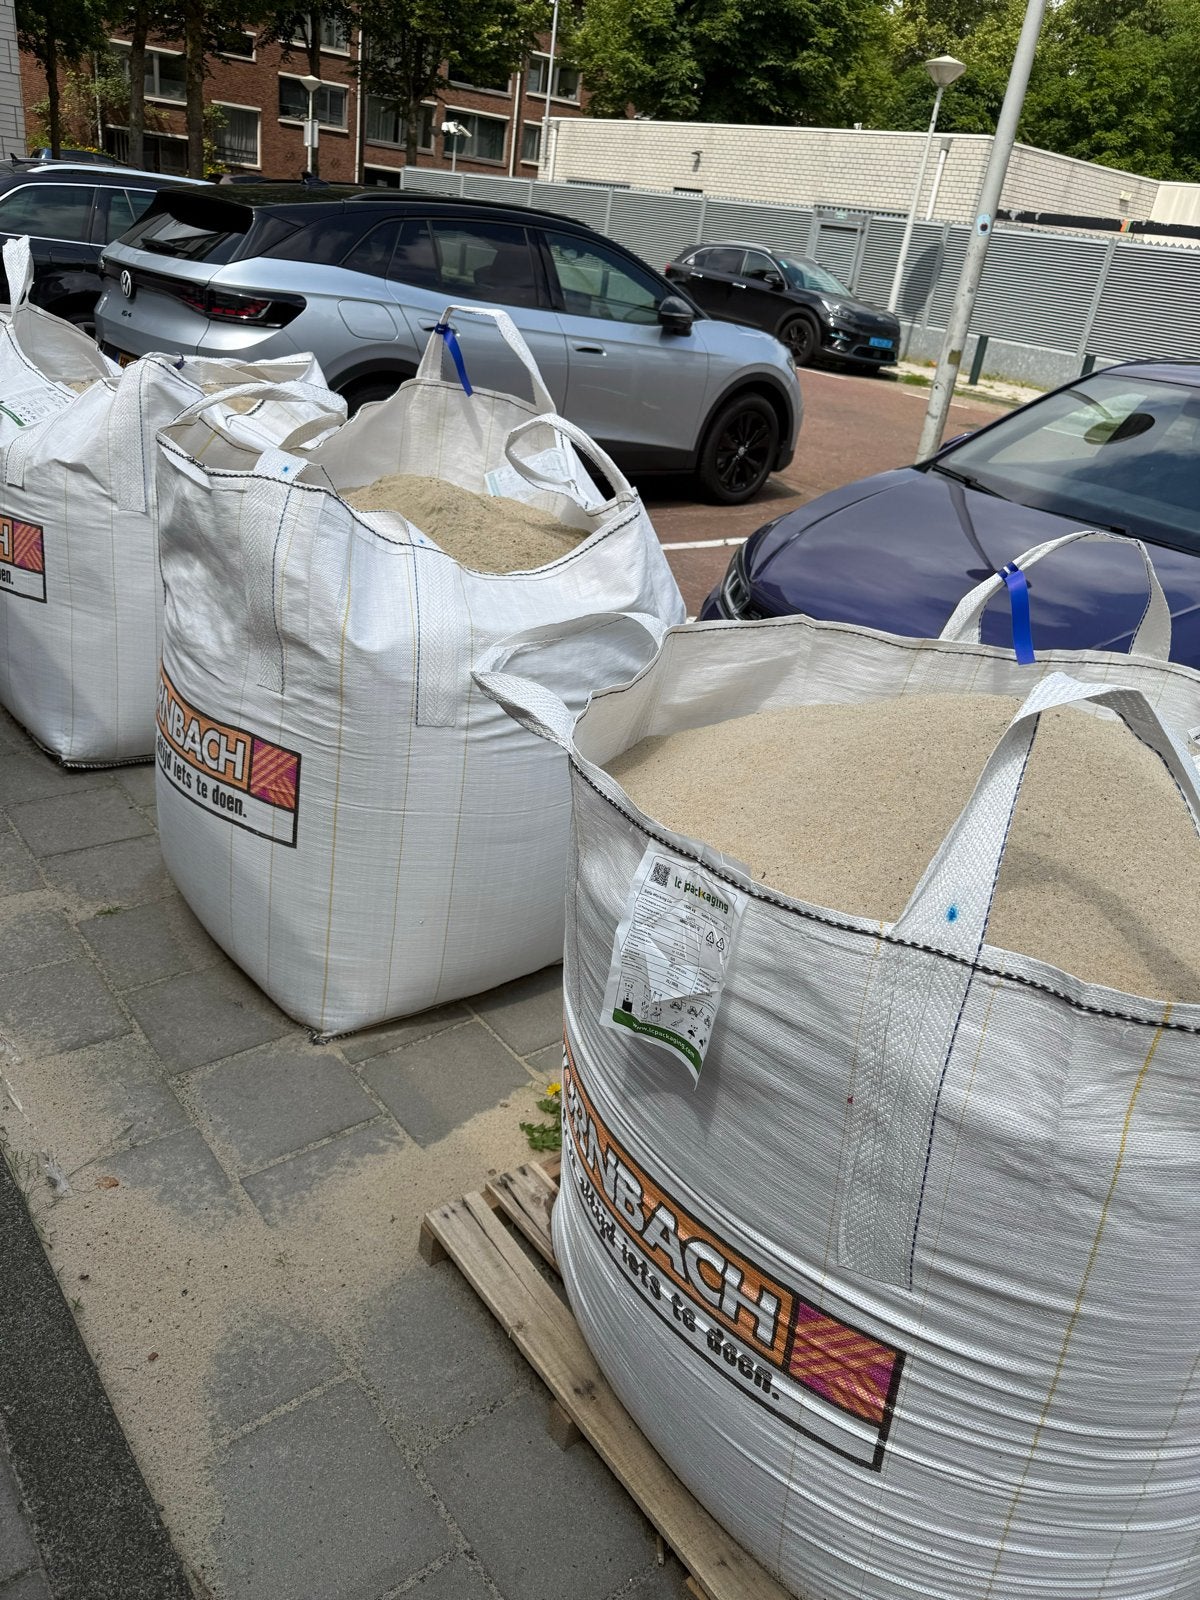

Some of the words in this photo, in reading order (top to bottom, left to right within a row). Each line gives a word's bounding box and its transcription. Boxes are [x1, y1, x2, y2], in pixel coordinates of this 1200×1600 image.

[174, 756, 192, 789] iets
[196, 775, 208, 799] te
[212, 785, 248, 818] doen.
[684, 881, 729, 915] packaging
[622, 1237, 662, 1301] iets
[671, 1293, 697, 1332] te
[707, 1327, 780, 1400] doen.
